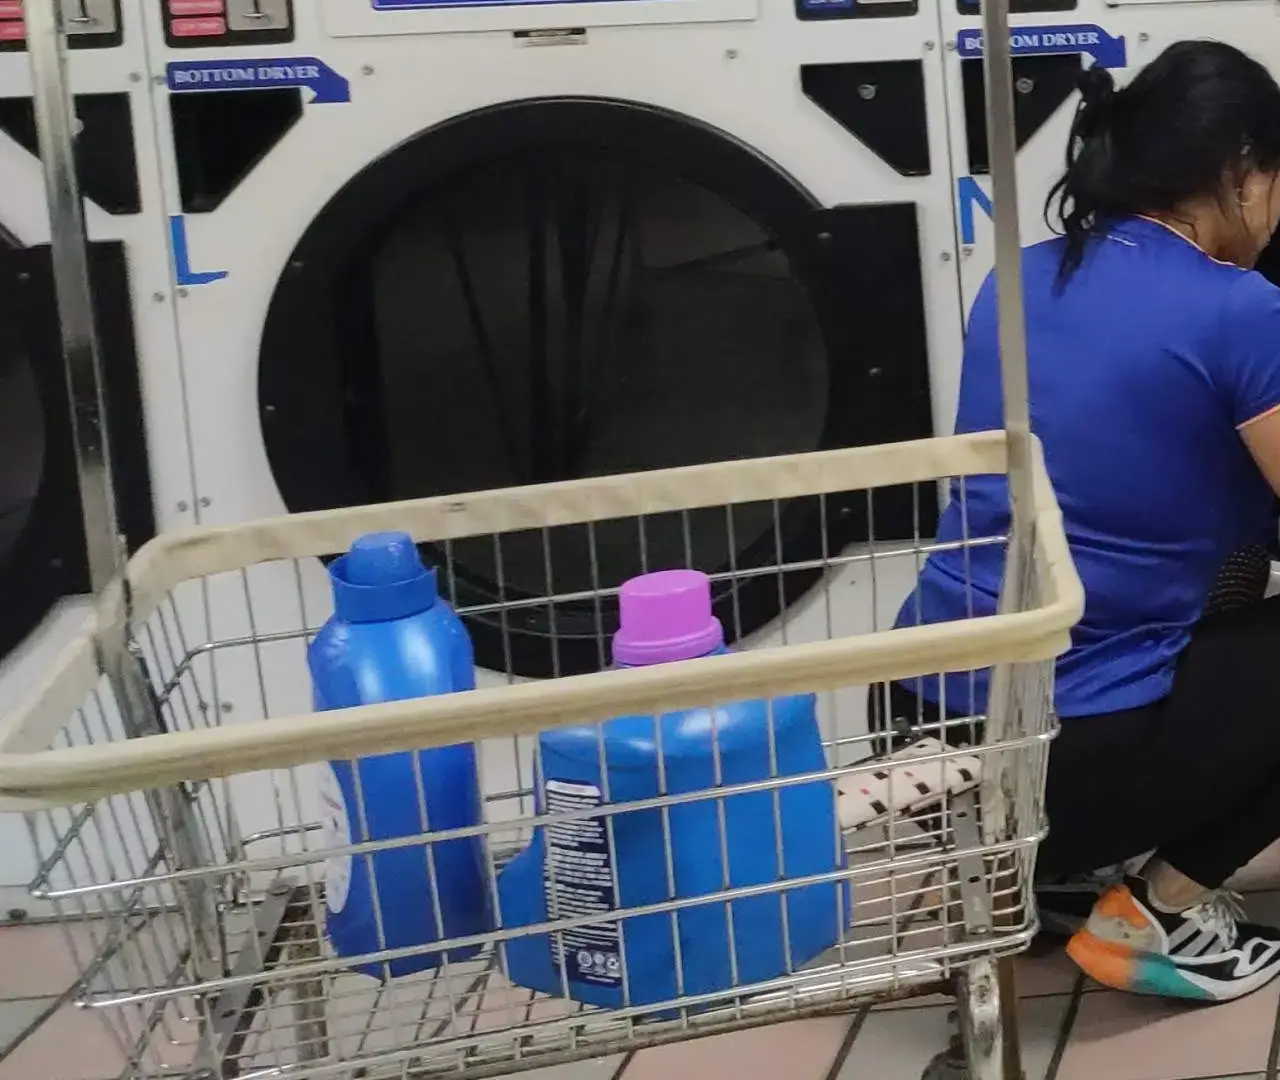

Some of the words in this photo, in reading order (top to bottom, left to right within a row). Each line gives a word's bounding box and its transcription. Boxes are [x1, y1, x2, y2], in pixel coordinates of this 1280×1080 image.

[964, 36, 1039, 50] BOOM
[1042, 32, 1100, 47] DRYER
[174, 68, 255, 83] BOTTOM
[257, 66, 320, 80] DRYER
[169, 215, 229, 285] L
